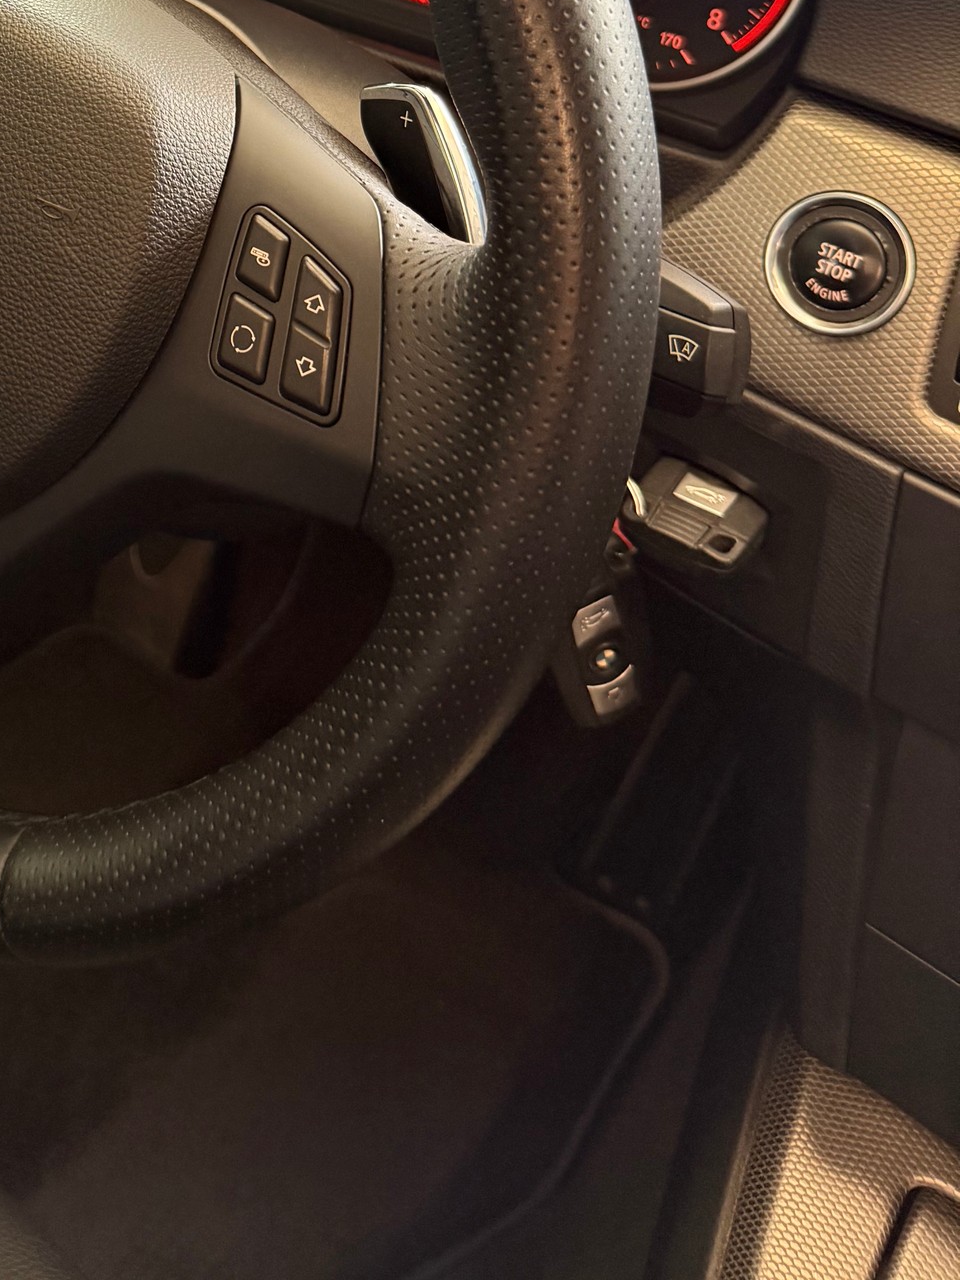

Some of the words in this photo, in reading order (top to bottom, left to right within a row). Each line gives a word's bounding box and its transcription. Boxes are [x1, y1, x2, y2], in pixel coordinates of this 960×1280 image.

[706, 8, 725, 30] 8
[660, 31, 682, 50] 170
[817, 241, 863, 269] START
[815, 259, 853, 282] STOP
[804, 277, 850, 303] ENGINE
